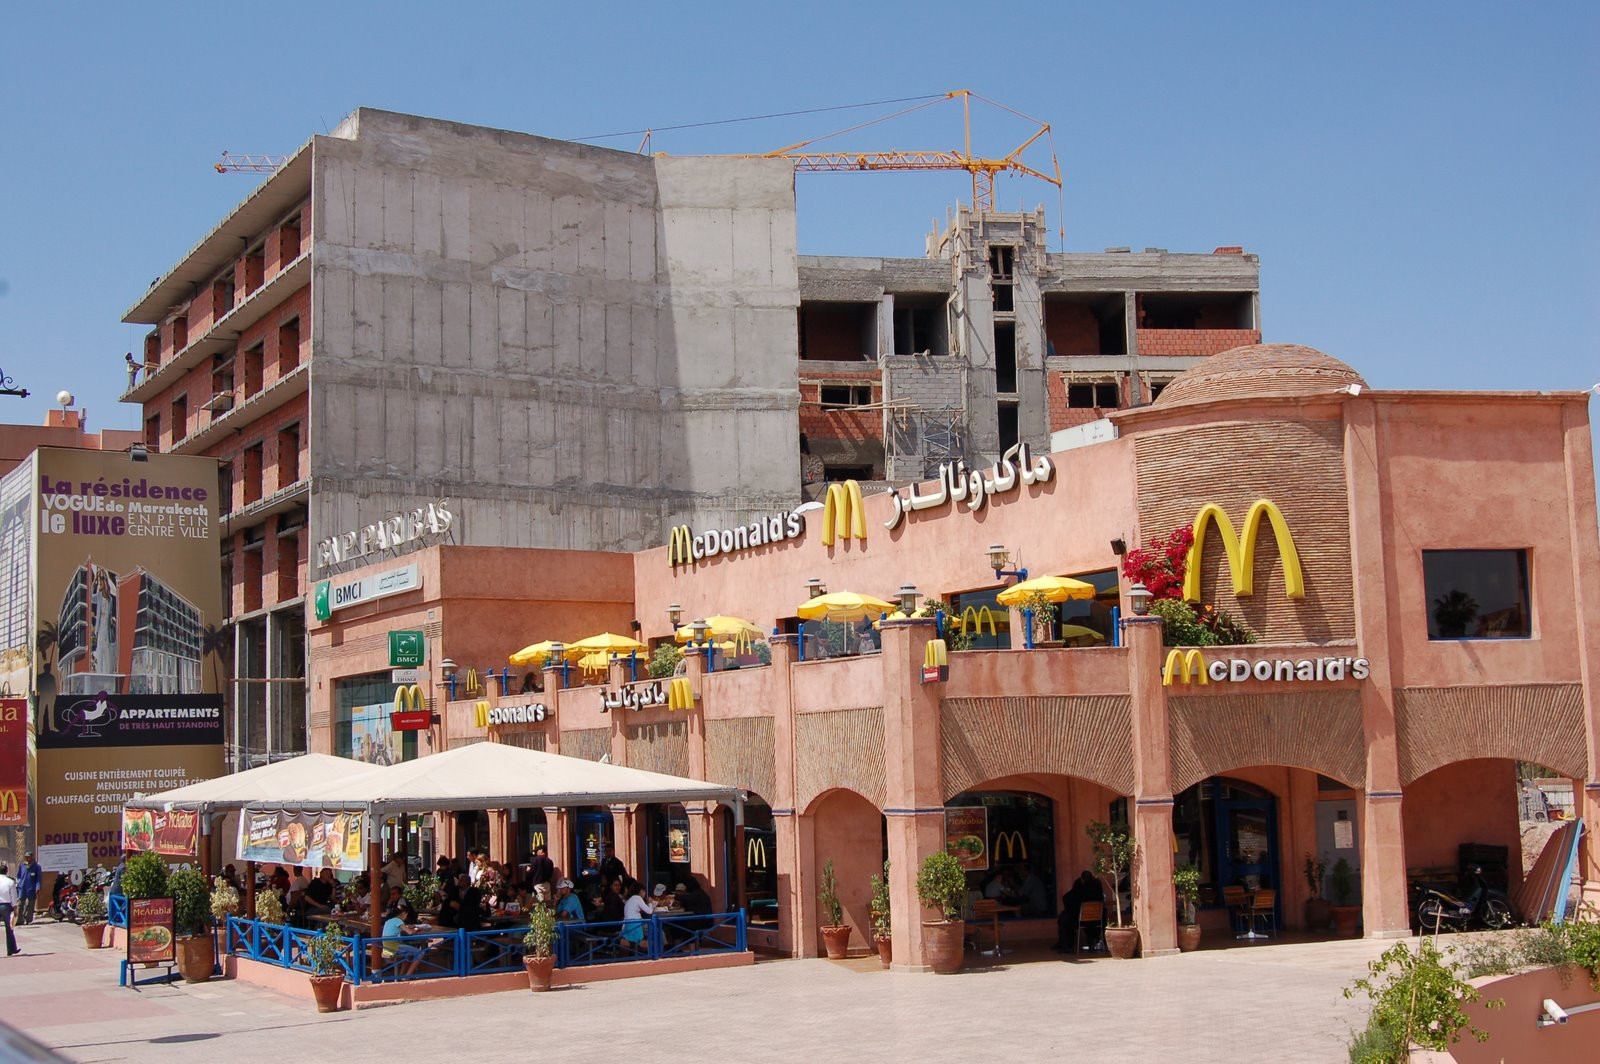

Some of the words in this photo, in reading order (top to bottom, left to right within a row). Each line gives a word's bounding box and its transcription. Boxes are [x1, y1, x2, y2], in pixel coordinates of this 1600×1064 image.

[42, 475, 71, 494] La
[81, 477, 207, 501] résidence
[884, 442, 1053, 530] ماكدونالدز
[42, 494, 104, 511] VOGUE
[106, 500, 124, 512] de
[129, 502, 207, 516] Marrakech
[42, 510, 65, 533] le
[73, 511, 125, 535] luxe
[128, 513, 150, 524] EN
[158, 515, 208, 527] PLEIN
[360, 497, 453, 555] PARIBAS
[128, 525, 174, 537] CENTRE
[180, 527, 208, 539] VILLE
[668, 511, 802, 568] McDonald's
[336, 581, 362, 604] BMCI
[1163, 649, 1370, 686] McDonald's
[599, 681, 666, 713] ماكدونالدز
[120, 708, 219, 719] APPARTEMENTS
[475, 701, 547, 728] McDonald's
[132, 721, 150, 730] TRÈS
[177, 721, 219, 729] STANDING
[64, 772, 97, 780] CUISINE
[100, 769, 152, 779] ENTIÈREMENT
[154, 767, 186, 777] EQUIPÉE
[96, 781, 145, 790] MENUISERIE
[159, 780, 177, 788] BOIS
[46, 794, 95, 804] CHAUFFAGE
[96, 793, 131, 802] CENTRAL
[94, 805, 123, 814] DOUBL
[45, 832, 80, 844] POUR
[82, 831, 113, 842] TOUT
[133, 906, 172, 916] McArabia
